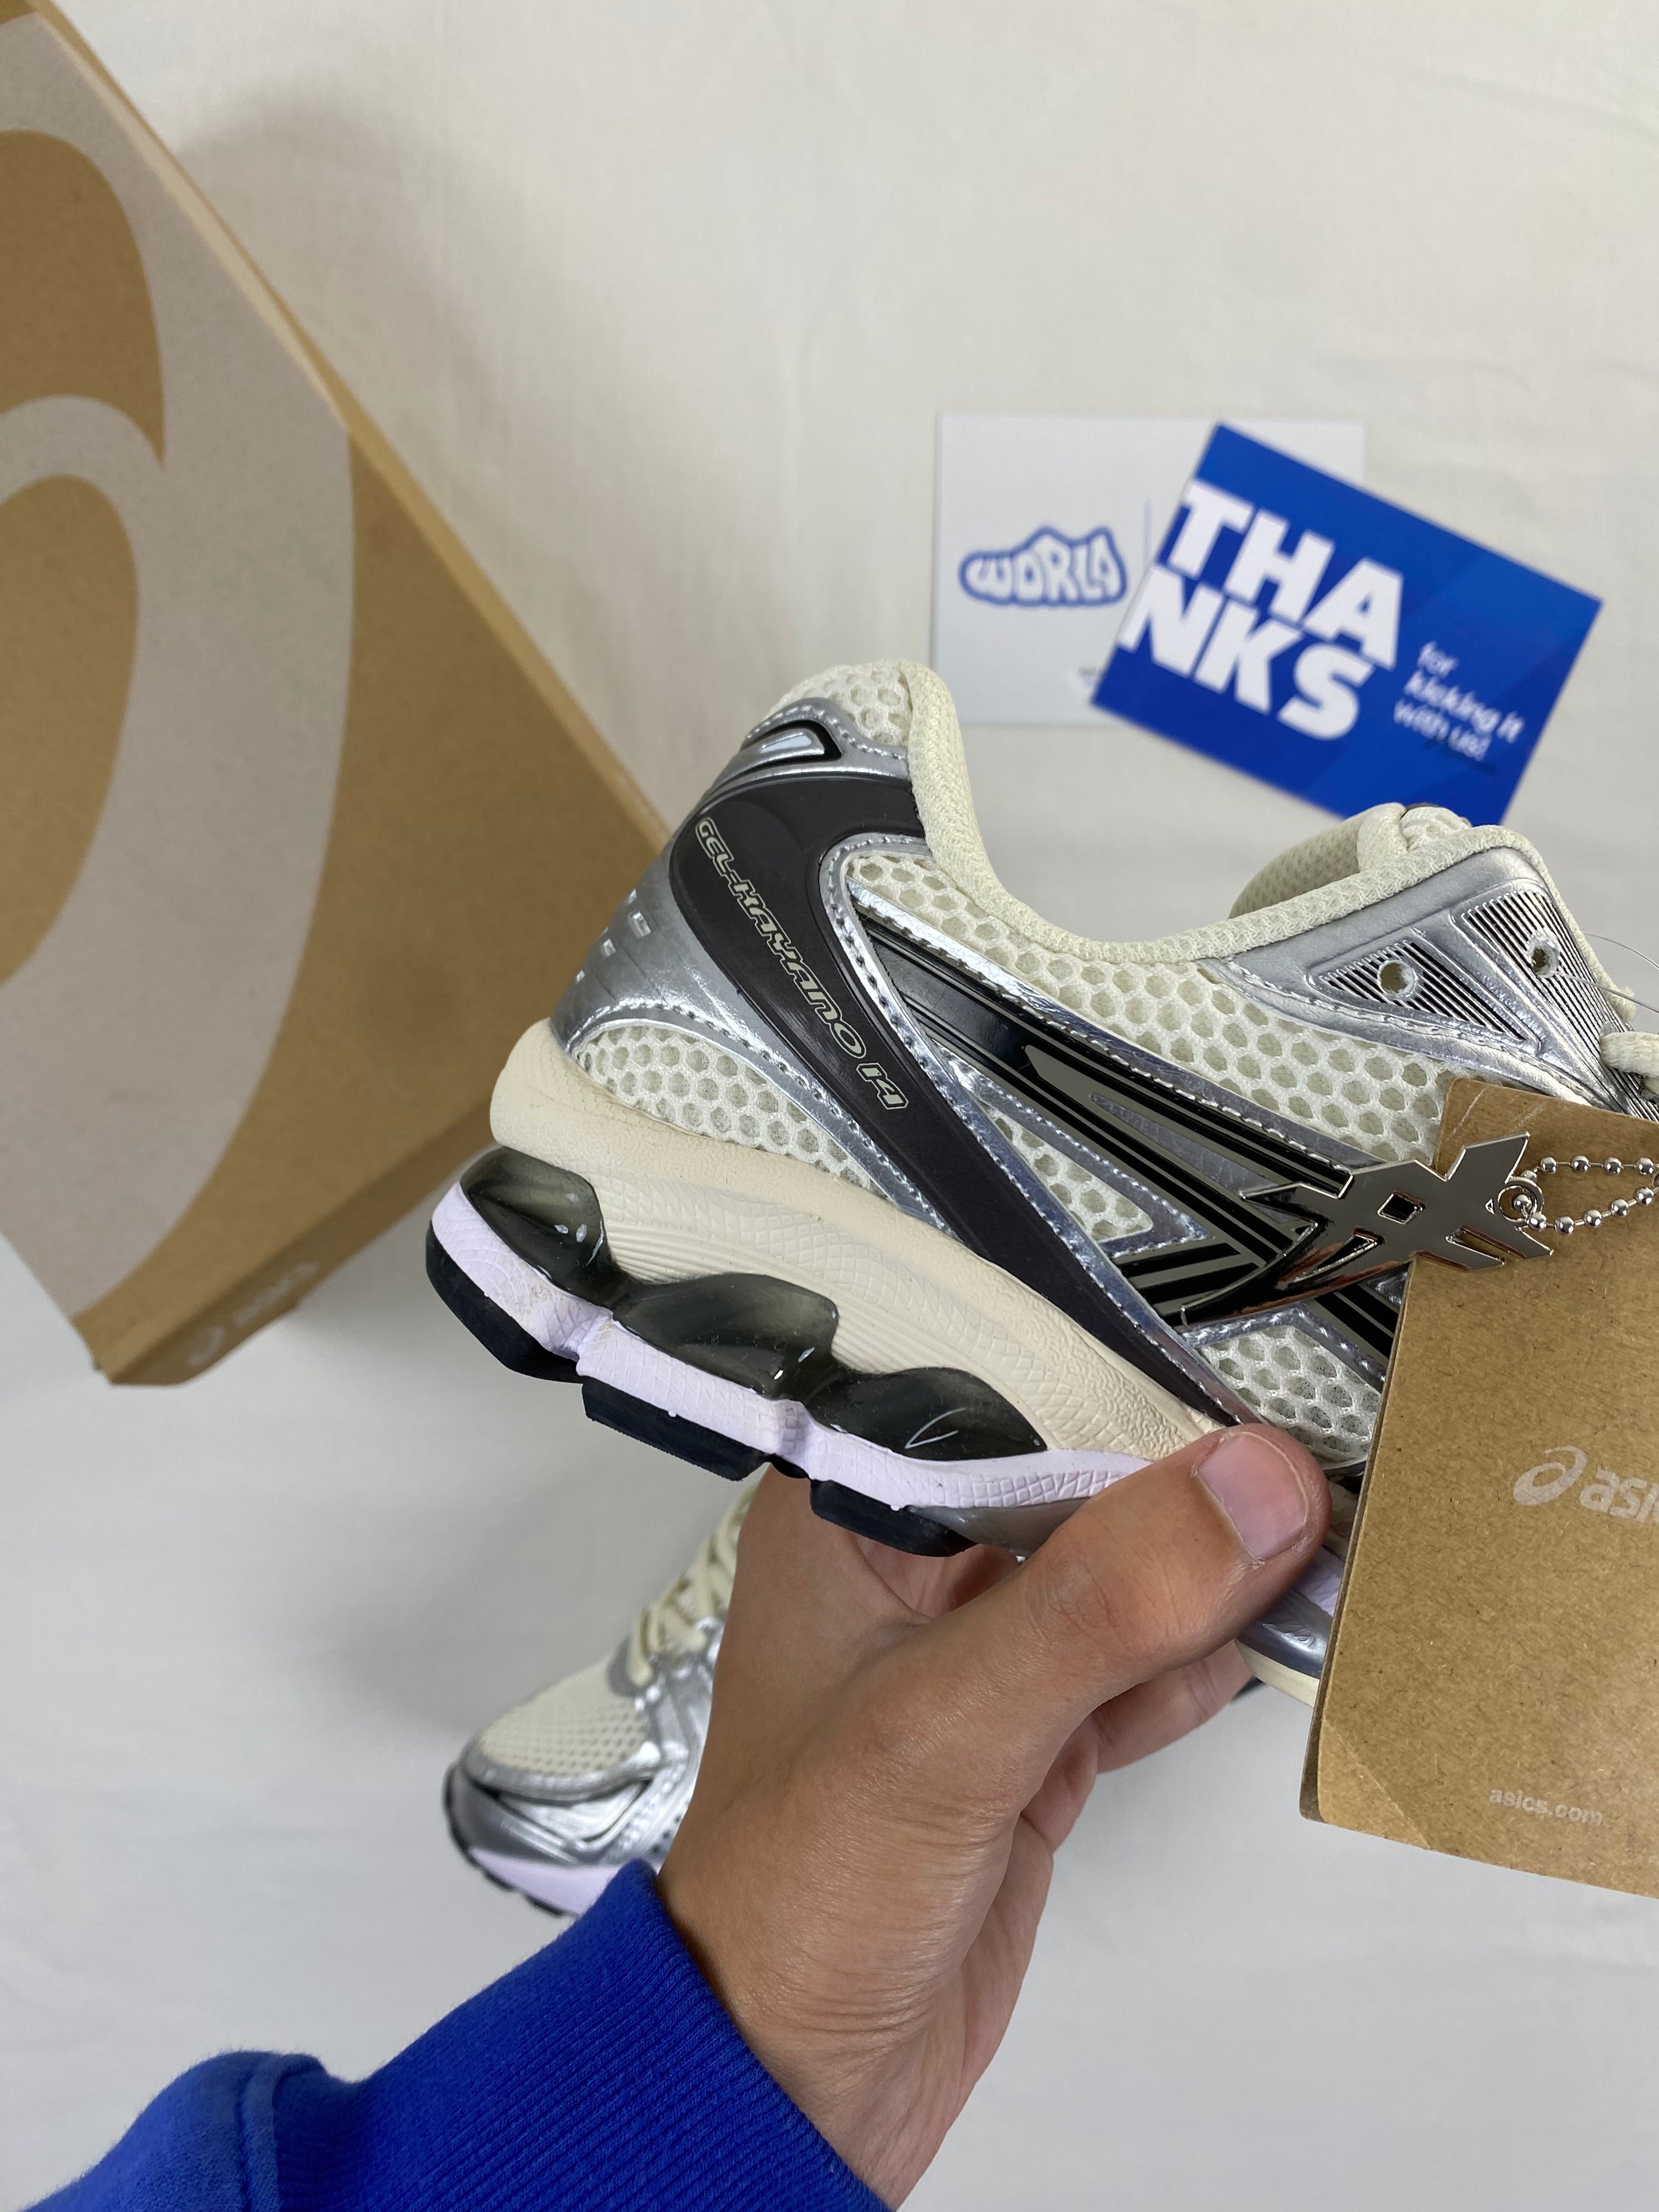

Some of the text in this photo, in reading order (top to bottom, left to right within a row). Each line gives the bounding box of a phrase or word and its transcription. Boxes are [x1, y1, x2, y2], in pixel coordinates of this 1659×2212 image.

[1176, 483, 1404, 669] THA
[1118, 566, 1375, 741] NKS
[1417, 641, 1458, 679] for
[1393, 699, 1449, 741] with
[1404, 669, 1525, 743] kicking it
[1580, 1468, 1659, 1523] asi
[1488, 1789, 1603, 1826] asics.com
